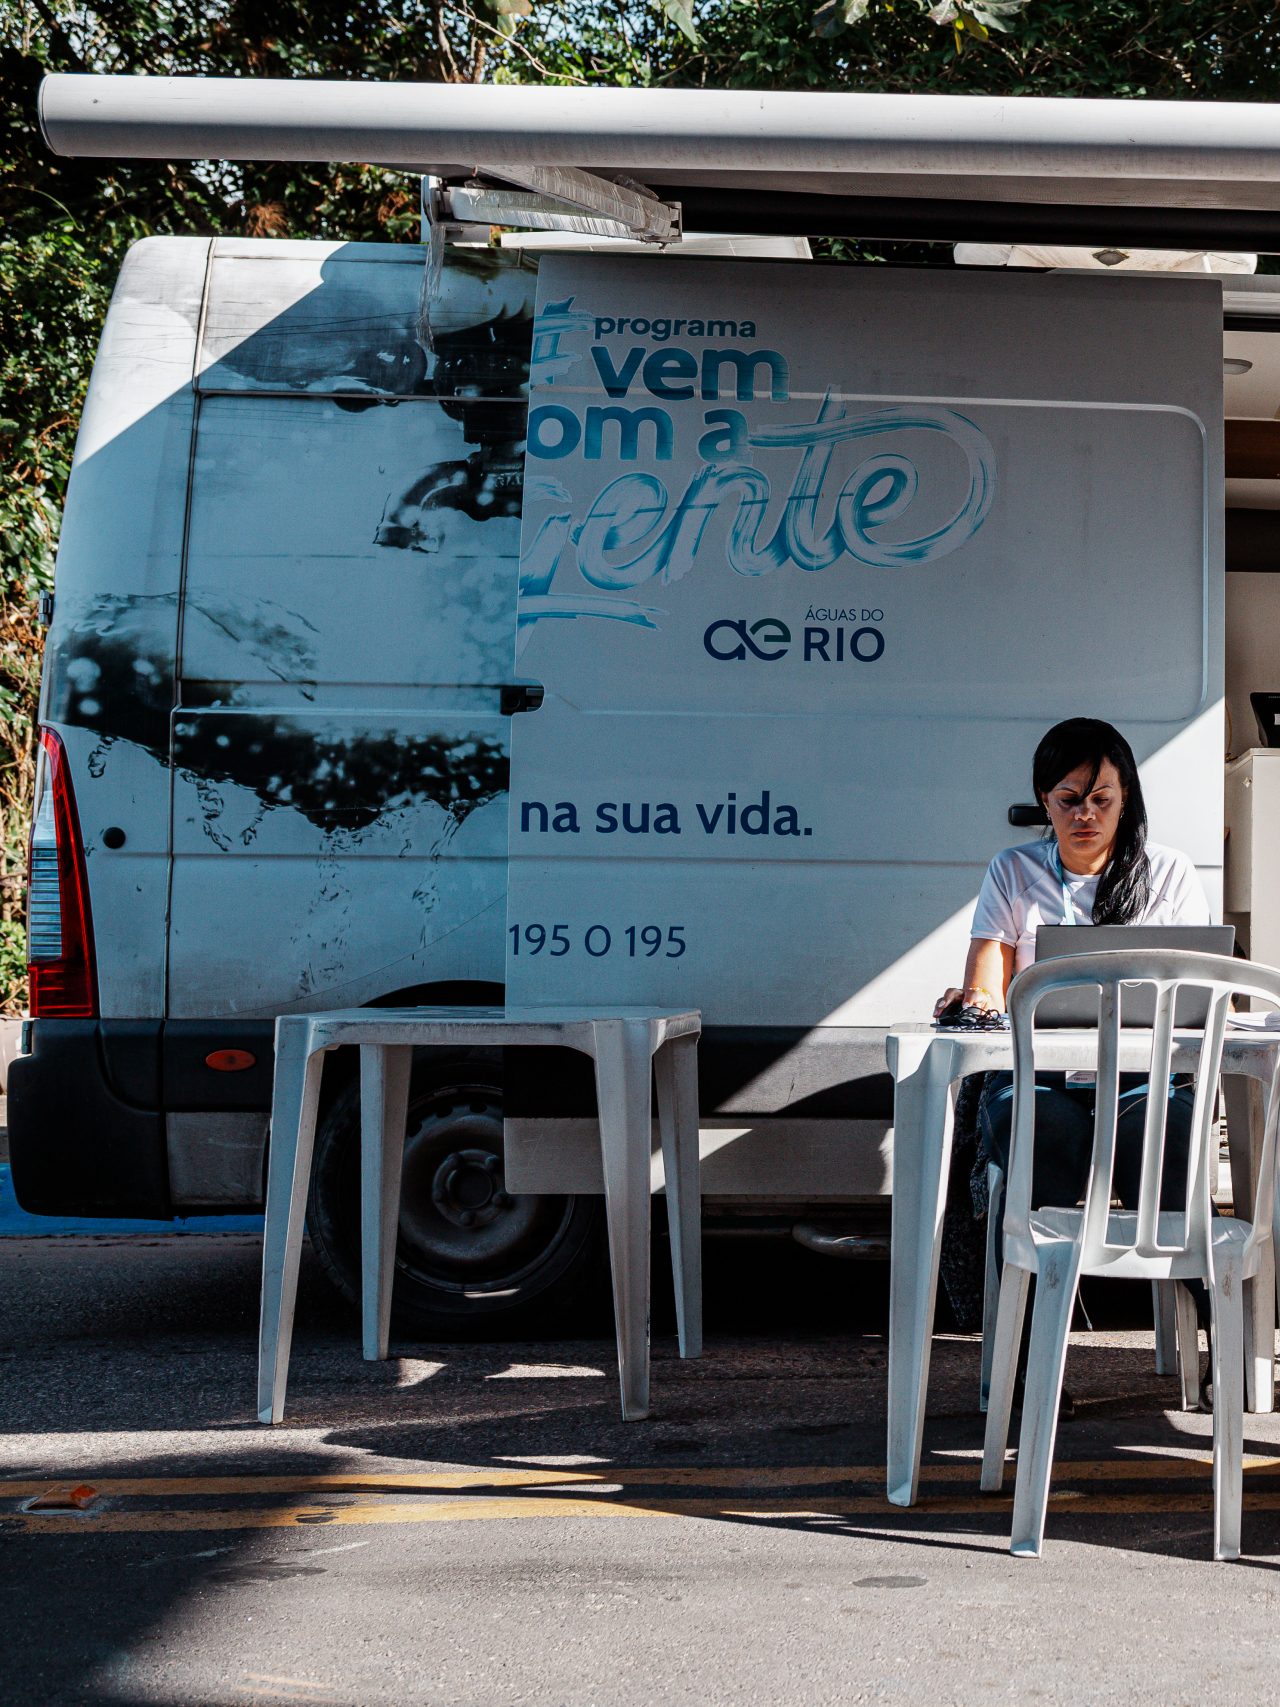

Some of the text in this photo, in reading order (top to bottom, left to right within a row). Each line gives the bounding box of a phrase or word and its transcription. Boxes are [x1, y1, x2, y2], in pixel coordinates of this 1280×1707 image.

[594, 315, 756, 342] programa
[591, 344, 790, 402] vem
[697, 408, 750, 463] a
[804, 604, 884, 622] ÁGUAS DO
[803, 626, 885, 663] RIO
[519, 789, 814, 837] na sua vida.
[508, 923, 571, 957] 195
[624, 925, 687, 958] 195
